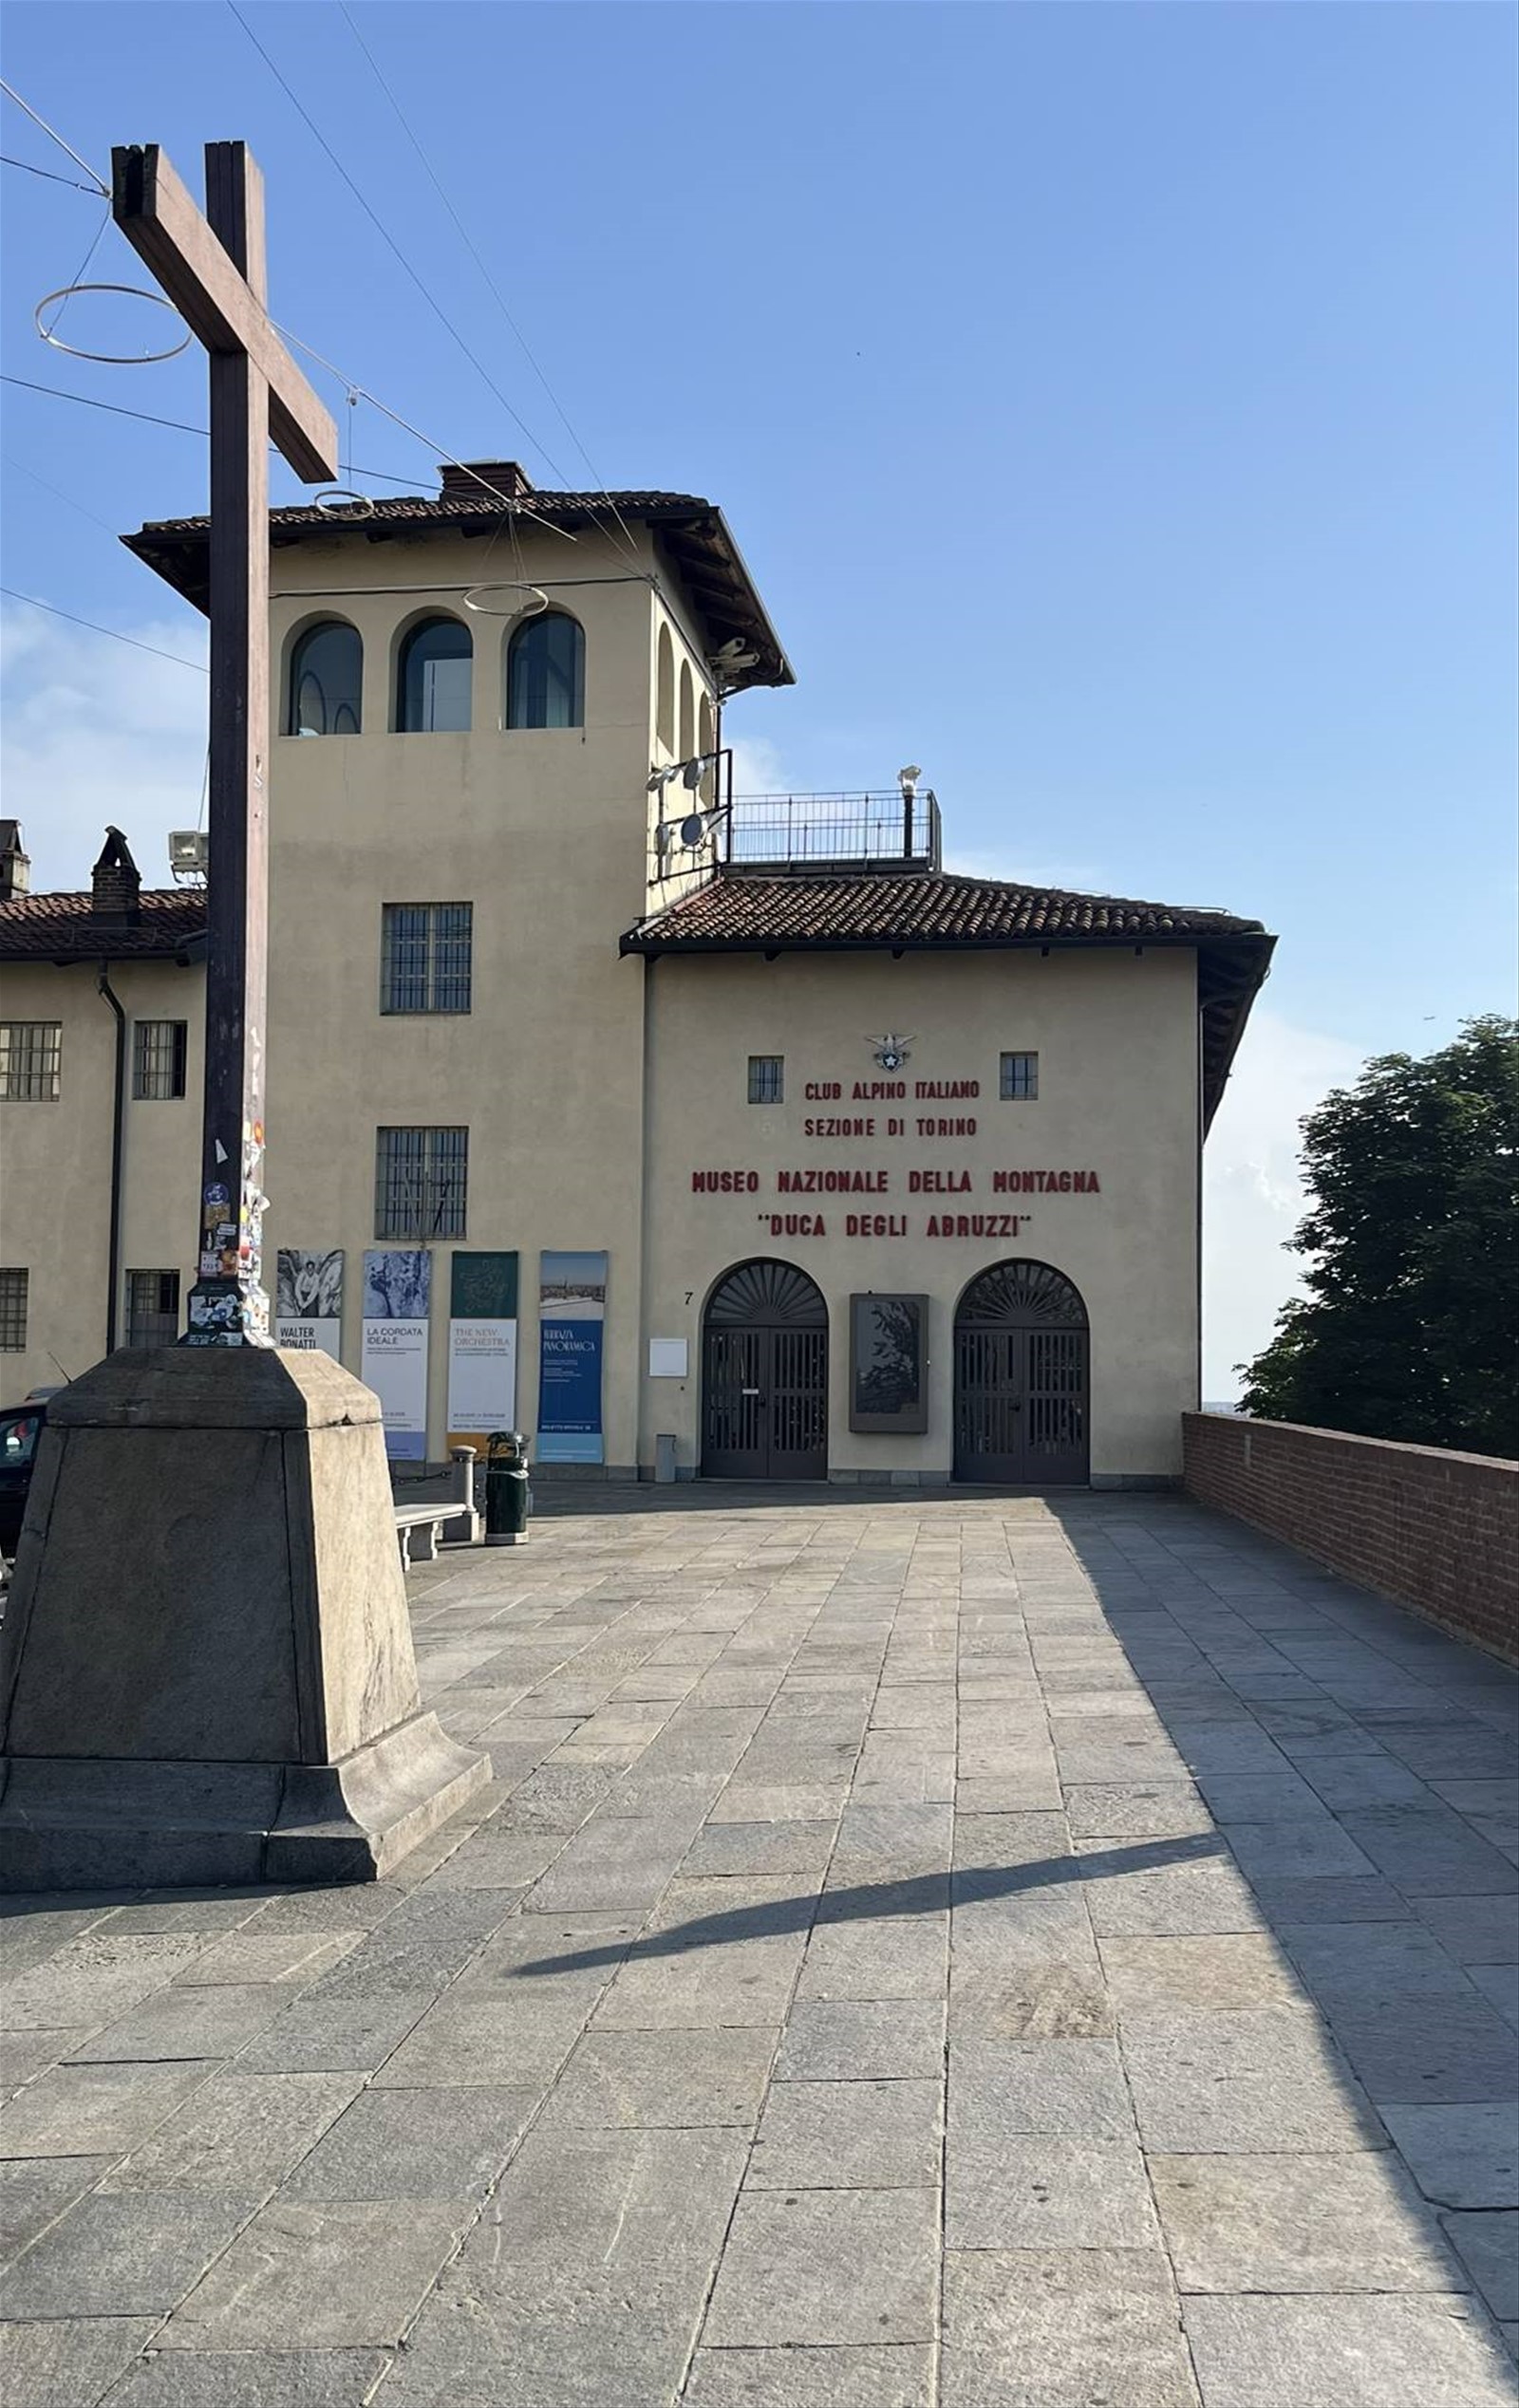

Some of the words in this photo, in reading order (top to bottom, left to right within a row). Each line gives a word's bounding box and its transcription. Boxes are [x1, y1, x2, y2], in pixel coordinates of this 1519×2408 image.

[805, 1082, 841, 1100] CLUB
[853, 1081, 906, 1100] ALPINO
[915, 1080, 980, 1099] ITALIANO
[804, 1119, 874, 1136] SEZIONE
[888, 1119, 904, 1136] DI
[916, 1118, 977, 1136] TORINO
[692, 1171, 759, 1192] MUSEO
[778, 1170, 889, 1192] NAZIONALE
[909, 1171, 972, 1192] DELLA
[993, 1171, 1100, 1193] MONTAGNA
[846, 1215, 907, 1237] DEGLI
[684, 1292, 694, 1305] 7
[280, 1327, 314, 1337] WALTER
[456, 1328, 473, 1336] THE
[475, 1328, 498, 1336] NEW
[455, 1337, 510, 1346] ORCHESTRA
